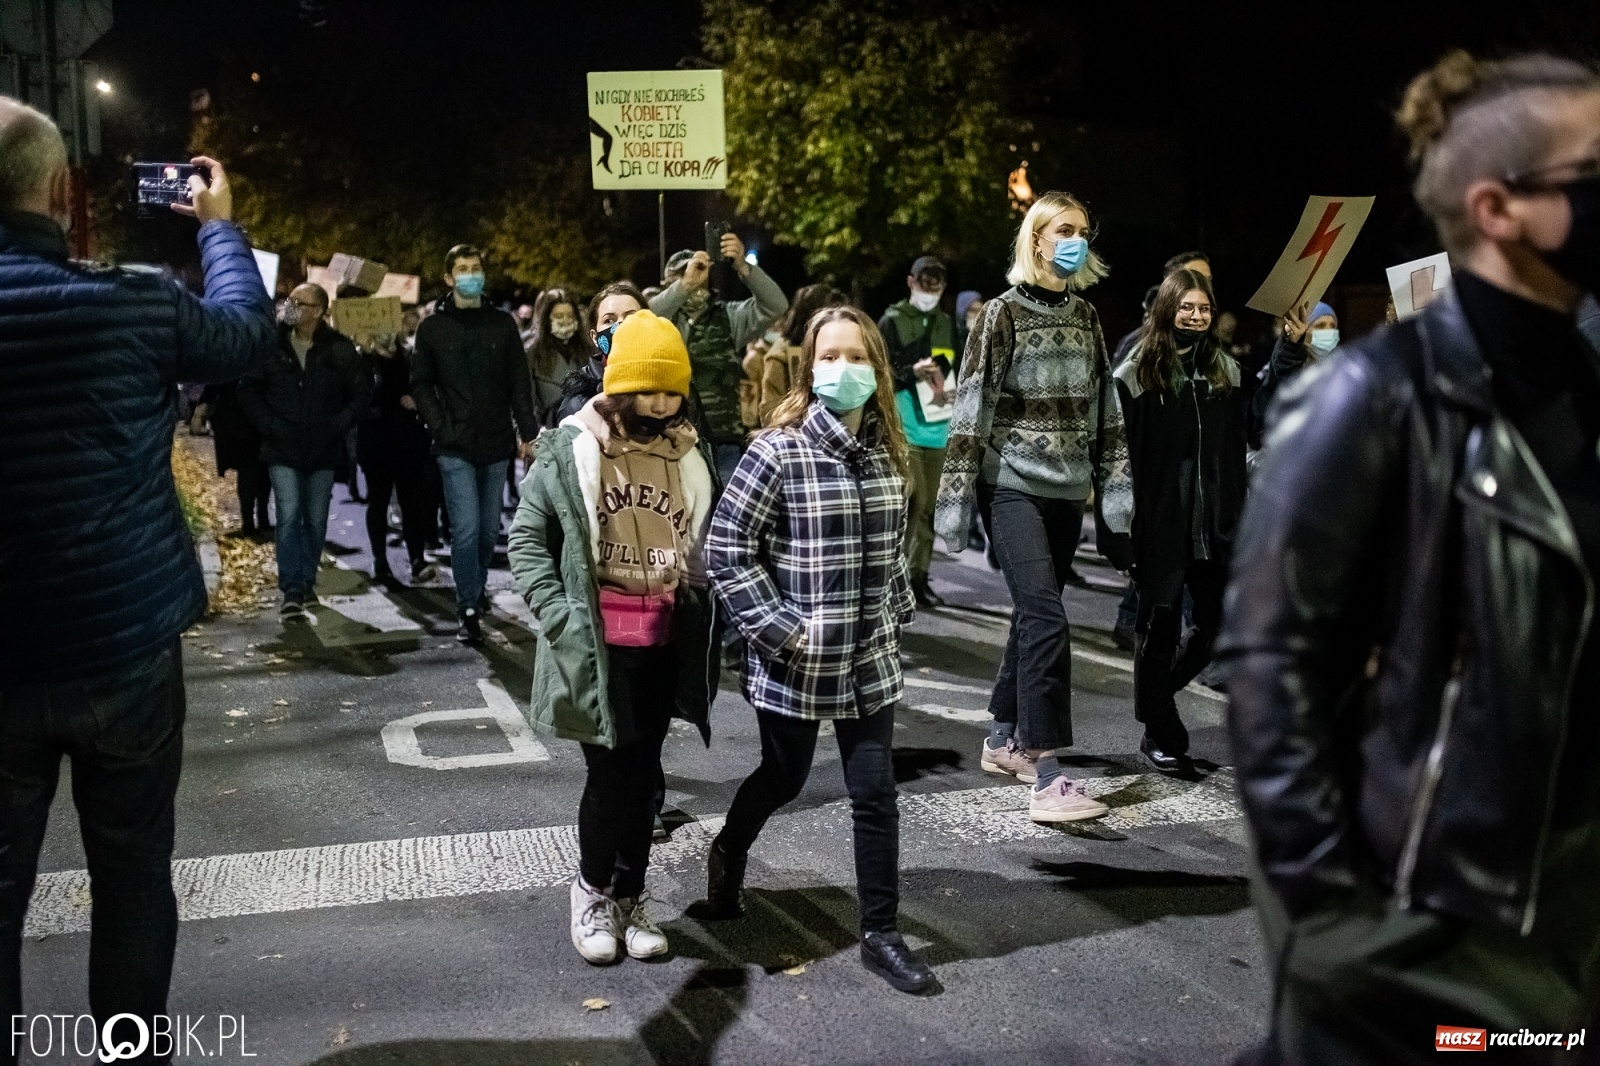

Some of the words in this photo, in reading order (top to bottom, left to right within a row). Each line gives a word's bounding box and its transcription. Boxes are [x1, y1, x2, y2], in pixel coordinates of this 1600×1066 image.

[595, 89, 631, 105] NIGDY
[634, 88, 651, 103] NIE
[655, 83, 705, 103] KOCHAŁEŚ
[621, 104, 682, 123] KOBIETY
[614, 124, 654, 140] WIĘC
[623, 141, 684, 158] KOBIETA
[618, 160, 642, 179] DA
[647, 161, 659, 175] CI
[664, 156, 725, 180] KOPA!!!
[647, 547, 667, 566] GO
[613, 567, 632, 578] HOPE
